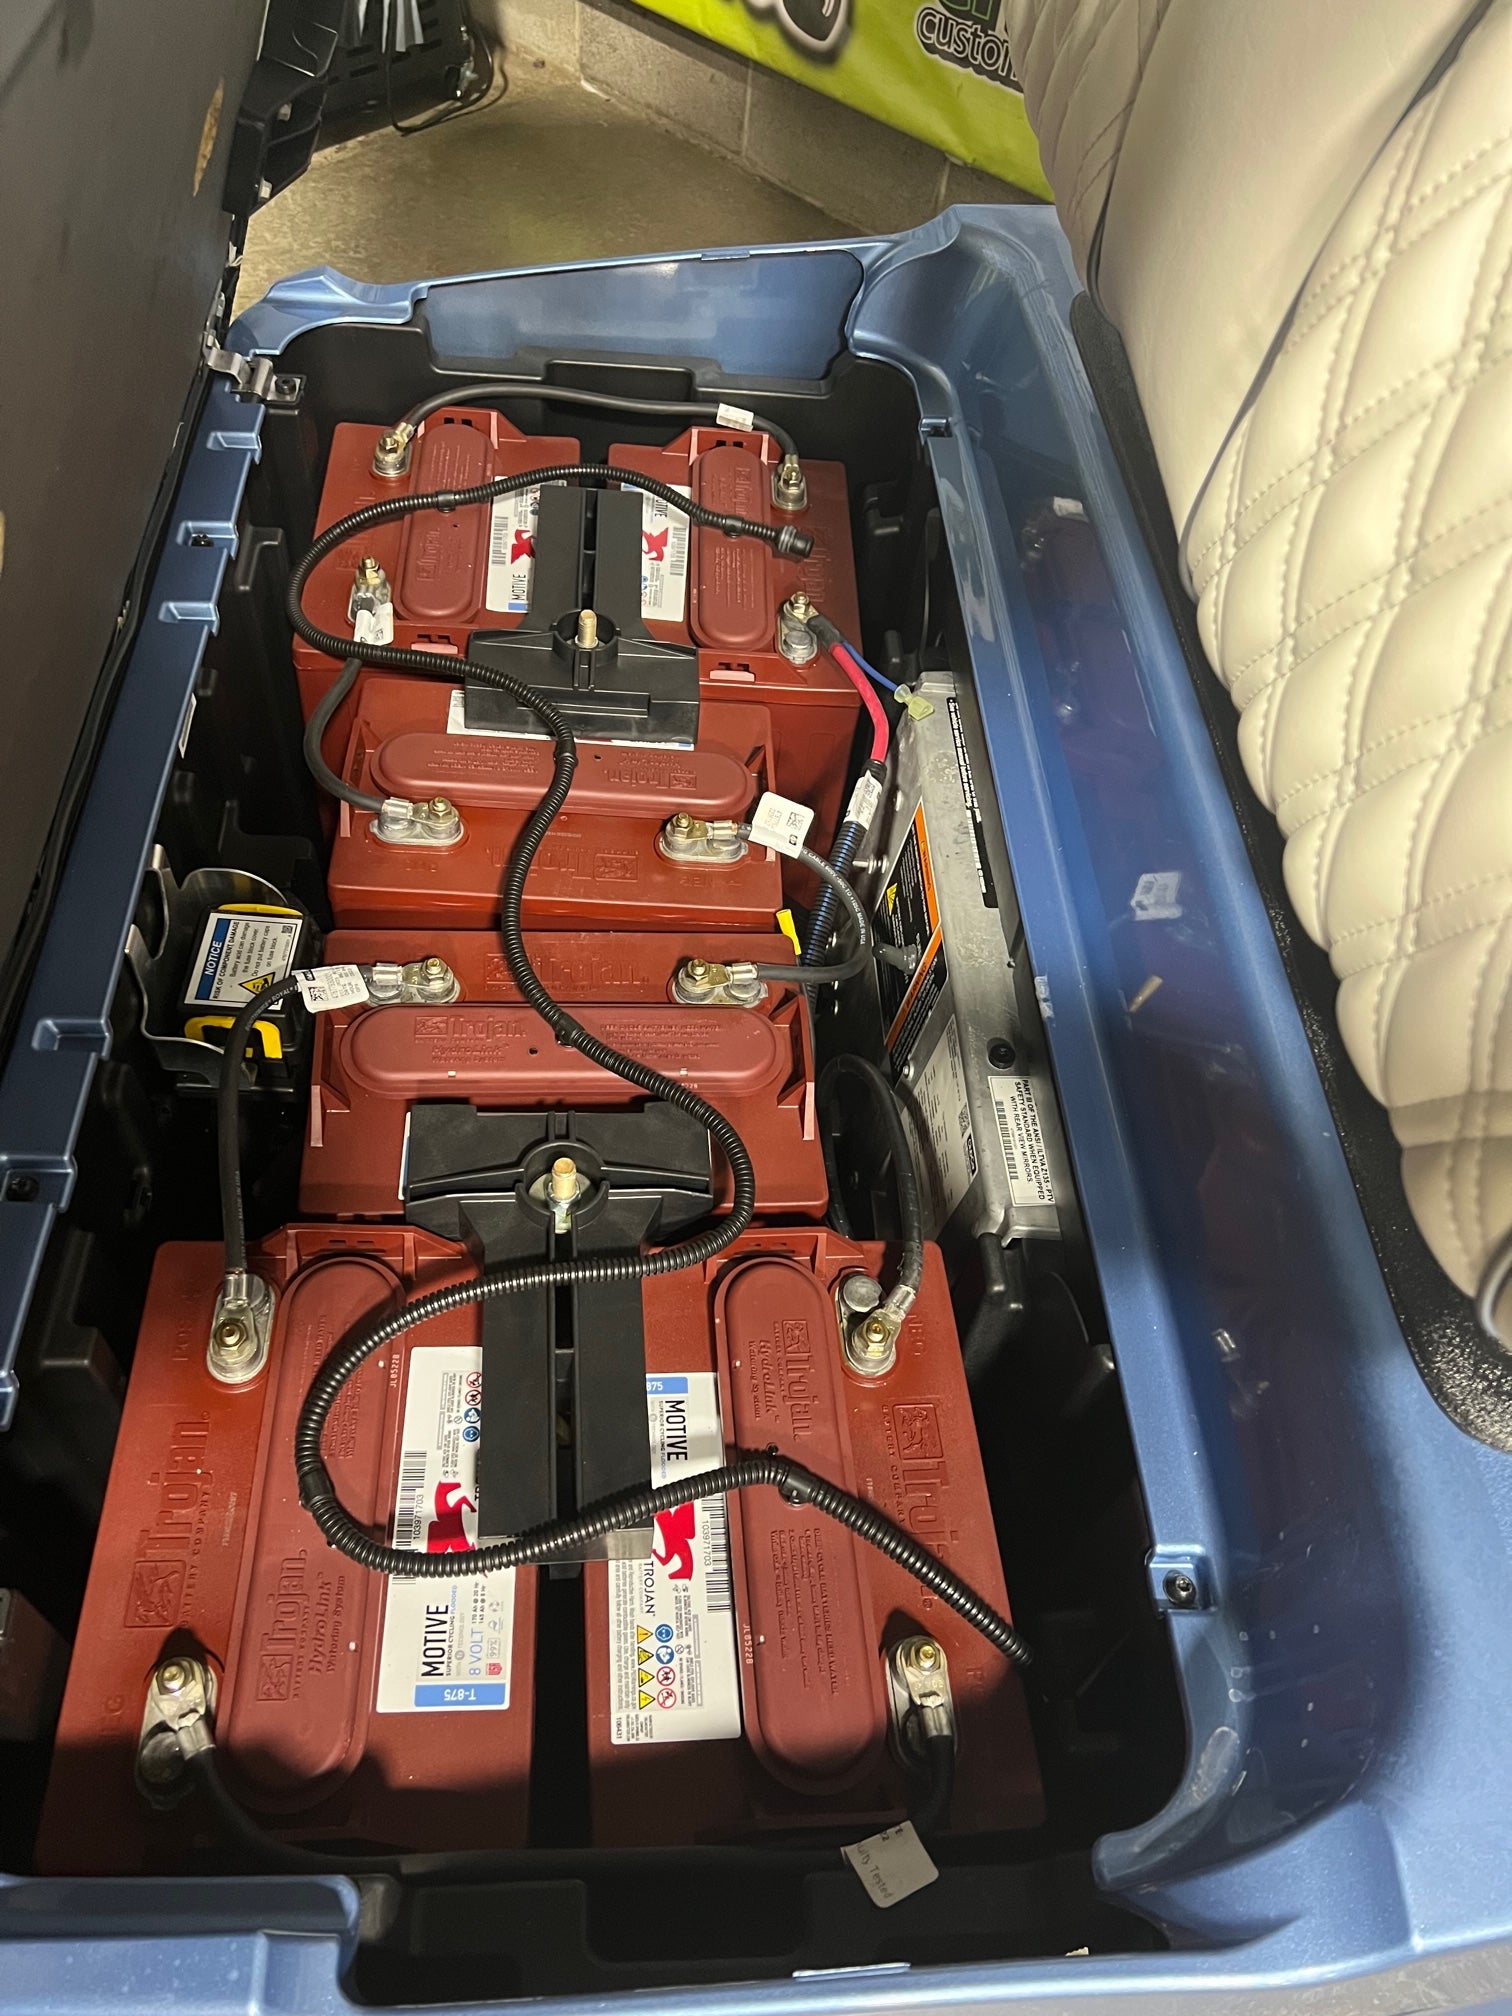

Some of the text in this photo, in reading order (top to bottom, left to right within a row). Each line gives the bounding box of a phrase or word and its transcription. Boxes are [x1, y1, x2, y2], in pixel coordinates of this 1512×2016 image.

[204, 940, 223, 976] NOTICE
[211, 920, 240, 999] RISK OF COMPONENT DAMAGE
[250, 968, 259, 977] Do
[449, 1013, 522, 1046] Trojan
[1009, 1095, 1018, 1112] WITH
[1021, 1078, 1030, 1096] PART
[1012, 1112, 1022, 1131] REAR
[1026, 1103, 1034, 1113] OF
[1029, 1113, 1037, 1127] THE
[1014, 1080, 1045, 1200] SAFETY STANDARD WHEN EQUIPPED
[1016, 1132, 1026, 1150] VIEW
[1031, 1127, 1041, 1144] ANSI
[1045, 1187, 1054, 1203] PTV
[783, 1354, 819, 1438] Trojan
[665, 1400, 688, 1461] MOTIVE
[139, 1420, 212, 1558] Trojan
[411, 1493, 425, 1540] 103971703
[700, 1519, 713, 1574] 103971703
[261, 1550, 307, 1648] Trojan
[643, 1560, 655, 1614] TROJAN
[421, 1605, 449, 1676] MOTIVE
[447, 1615, 455, 1643] CYCLING
[468, 1626, 484, 1665] VOLT
[445, 1643, 453, 1676] SUPERIOR
[489, 1638, 498, 1657] 99%
[467, 1666, 481, 1676] 8
[443, 1686, 477, 1701] T-875
